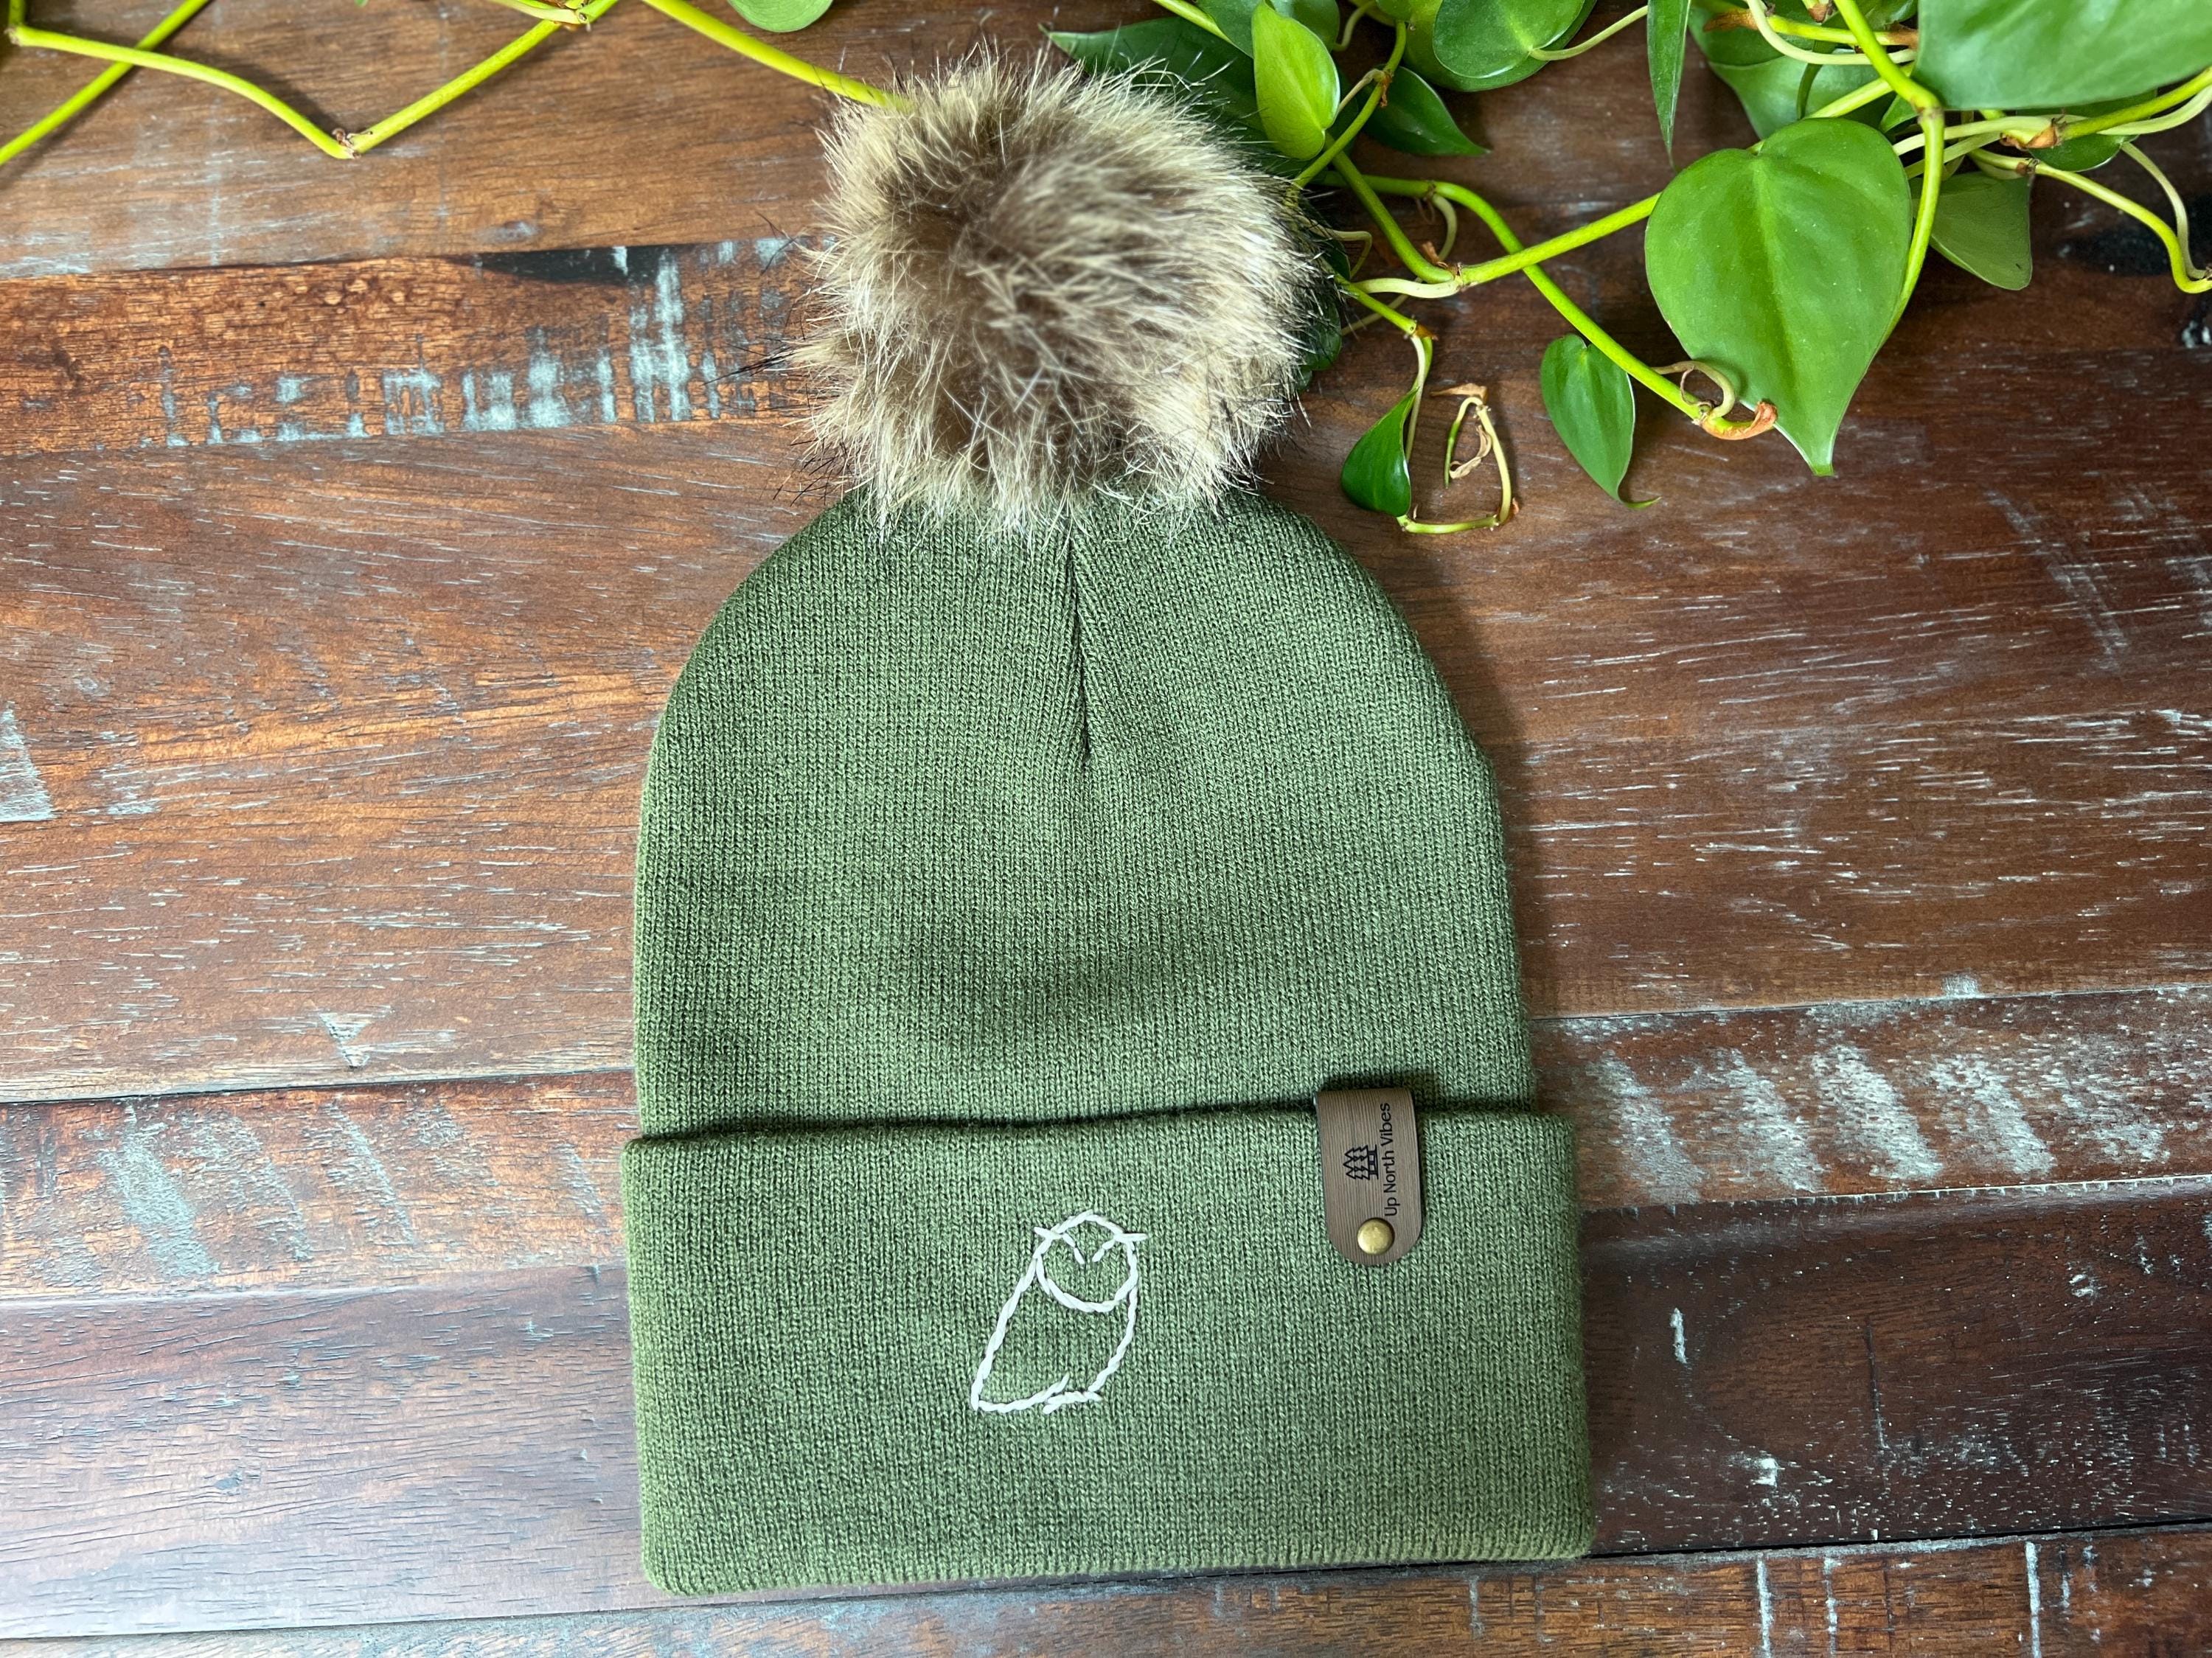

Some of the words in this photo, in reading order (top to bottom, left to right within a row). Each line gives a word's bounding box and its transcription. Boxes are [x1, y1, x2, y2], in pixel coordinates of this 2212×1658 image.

[1379, 1102, 1394, 1146] Vibes
[1382, 1150, 1396, 1193] North
[1384, 1197, 1400, 1216] Up
